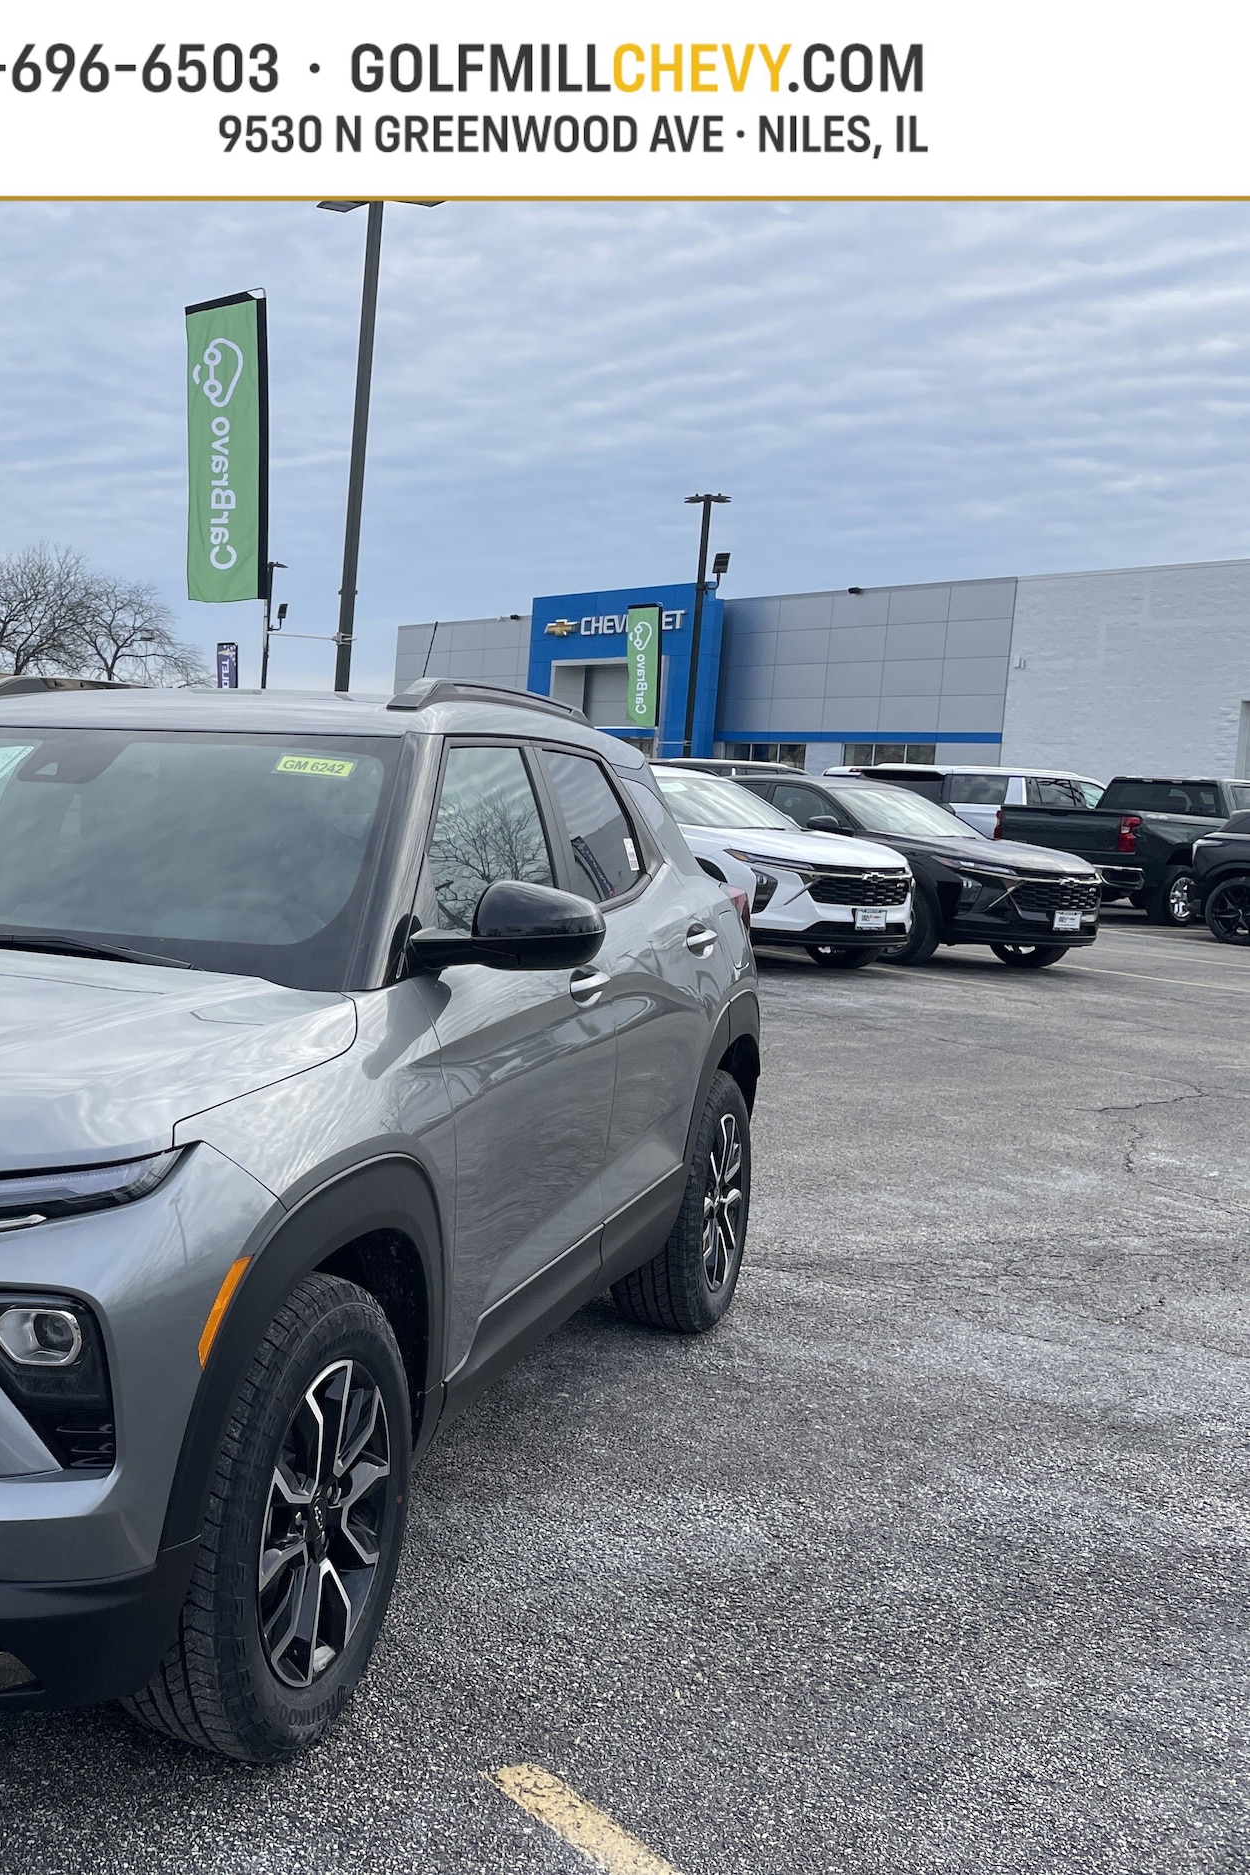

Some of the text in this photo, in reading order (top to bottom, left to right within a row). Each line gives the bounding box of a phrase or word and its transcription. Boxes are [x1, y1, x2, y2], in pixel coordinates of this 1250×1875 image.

[580, 610, 686, 636] CHEVET
[283, 760, 345, 774] GM 6242
